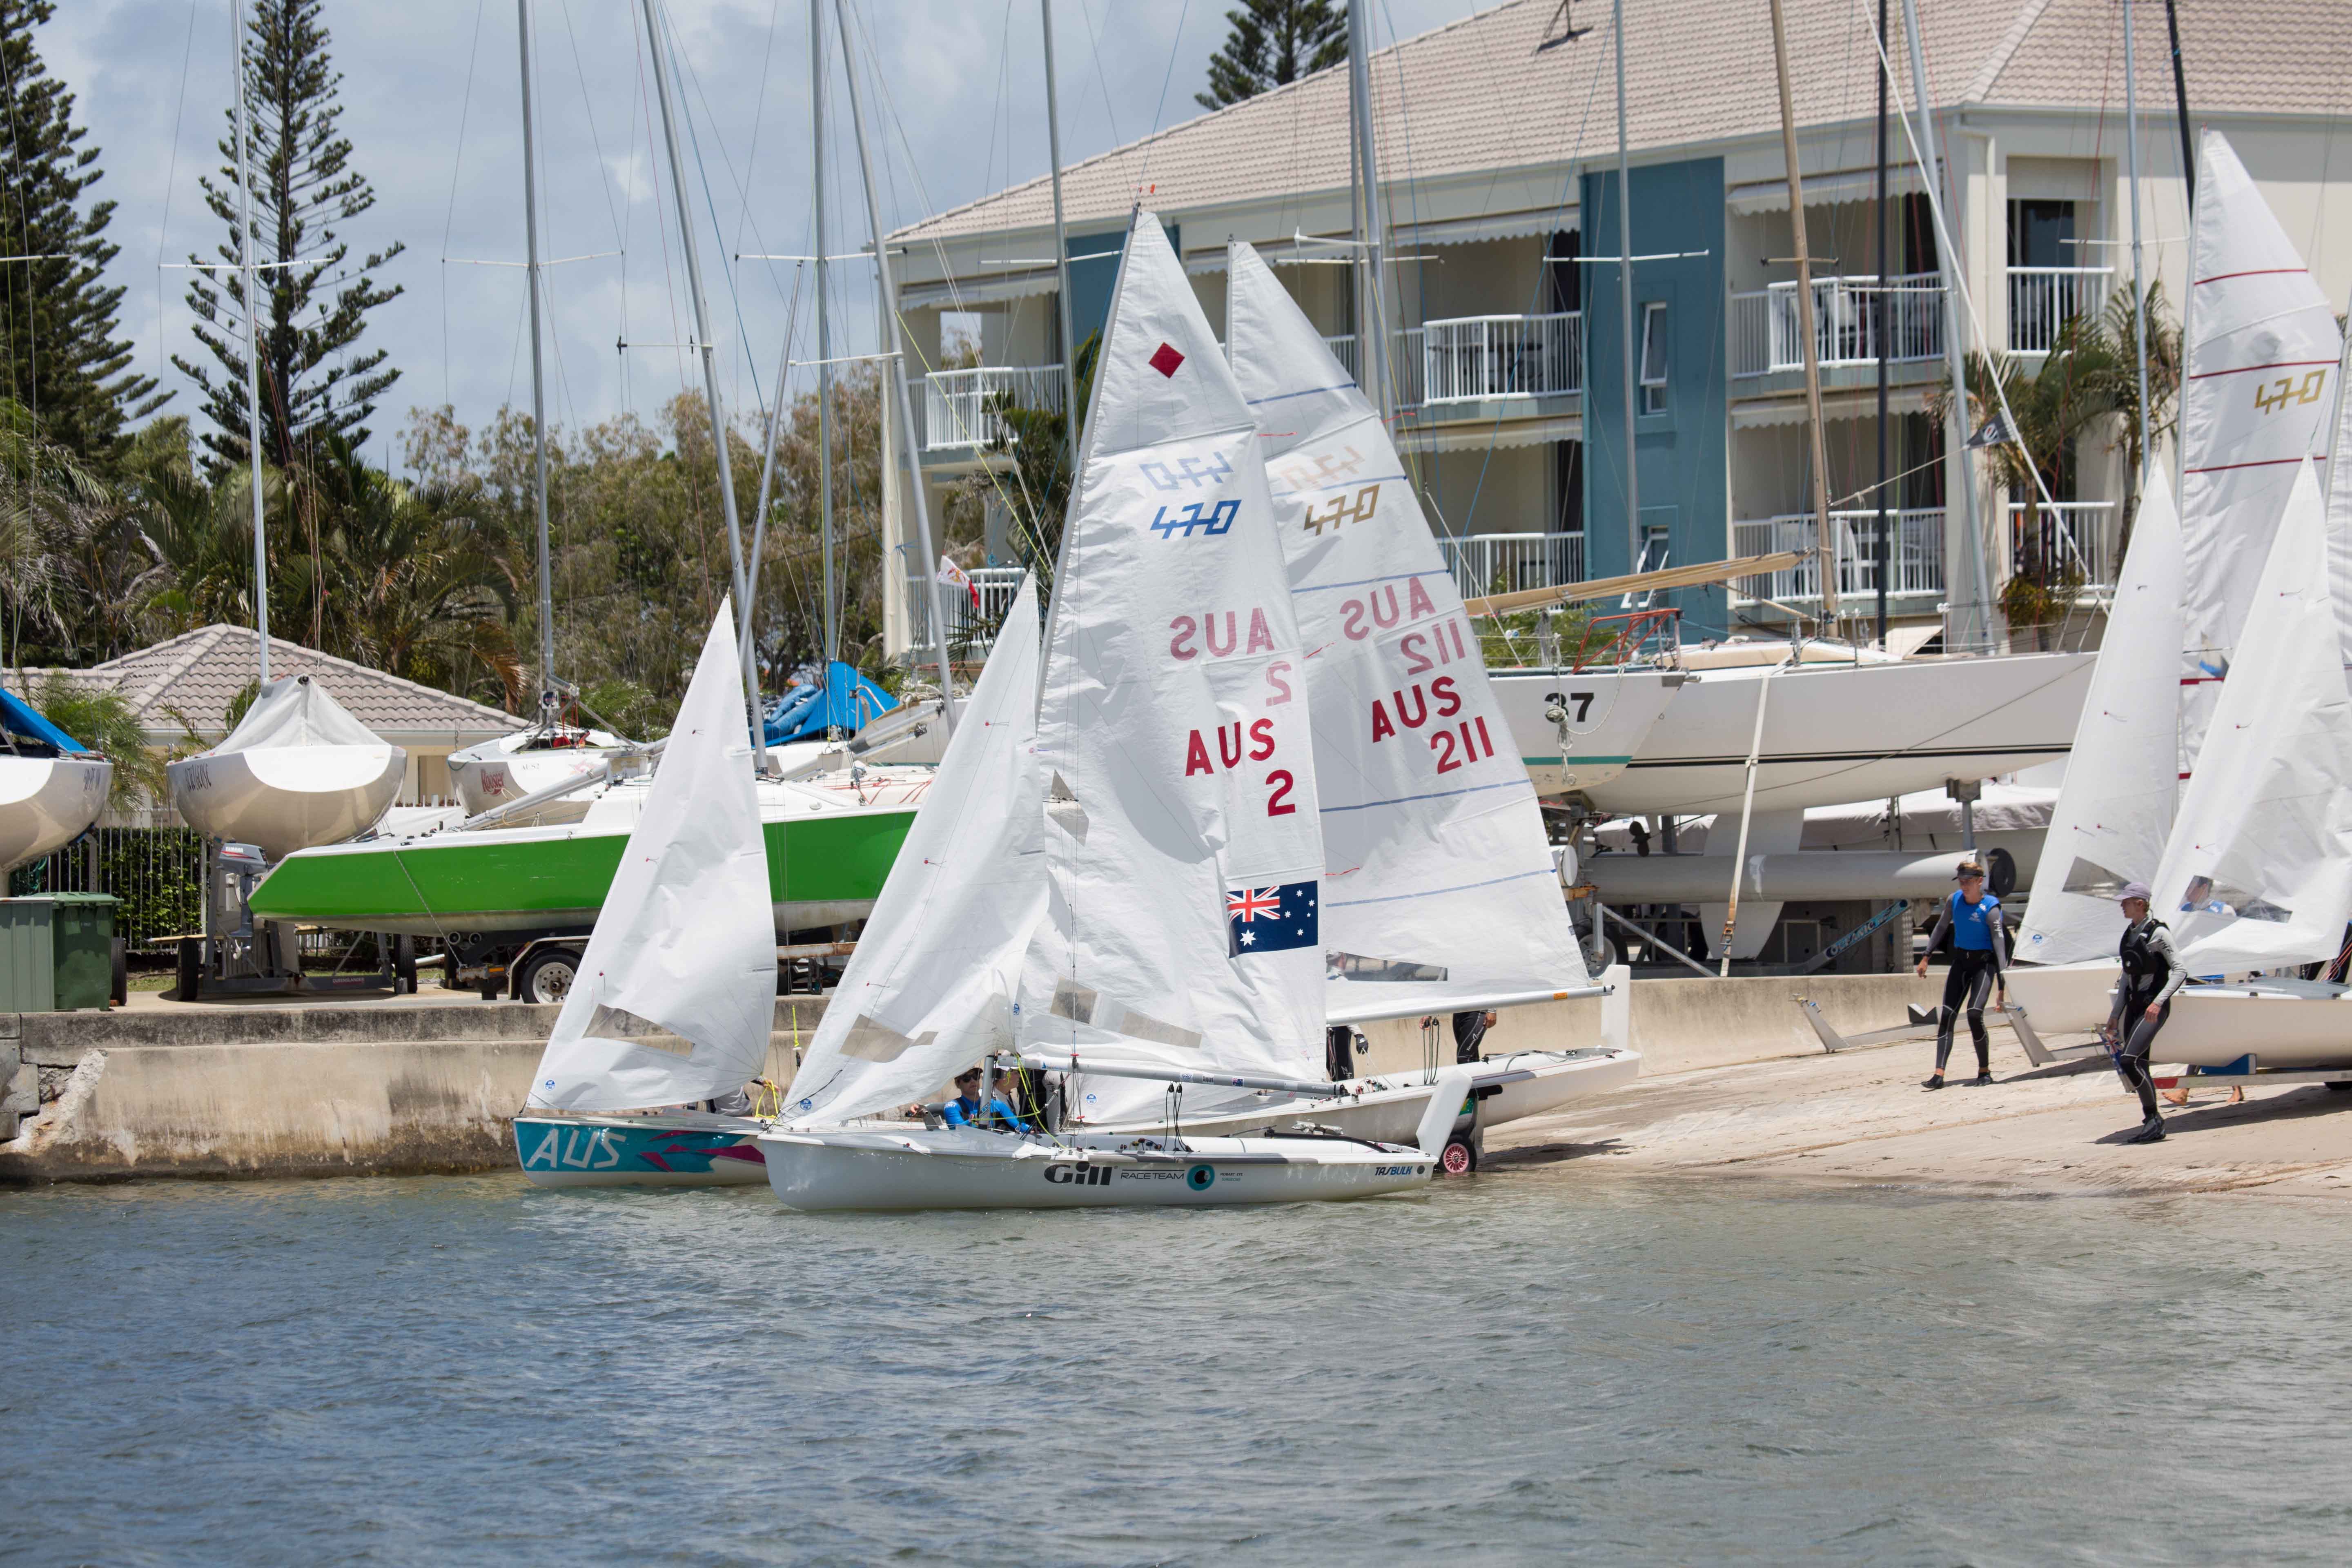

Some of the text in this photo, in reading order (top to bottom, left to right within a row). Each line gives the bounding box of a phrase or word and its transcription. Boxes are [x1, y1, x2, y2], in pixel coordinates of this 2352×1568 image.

[2254, 369, 2326, 415] 470
[1149, 499, 1242, 539] 470
[1303, 483, 1380, 536] 470
[1372, 677, 1461, 743] AUS
[1545, 693, 1595, 722] 37
[1185, 718, 1275, 776] AUS
[1430, 716, 1494, 774] 211
[1265, 769, 1296, 816] 2
[526, 1129, 627, 1168] AUS
[1044, 1161, 1113, 1185] Gill
[1152, 1172, 1185, 1180] TEAM
[1375, 1166, 1413, 1176] TASBULK
